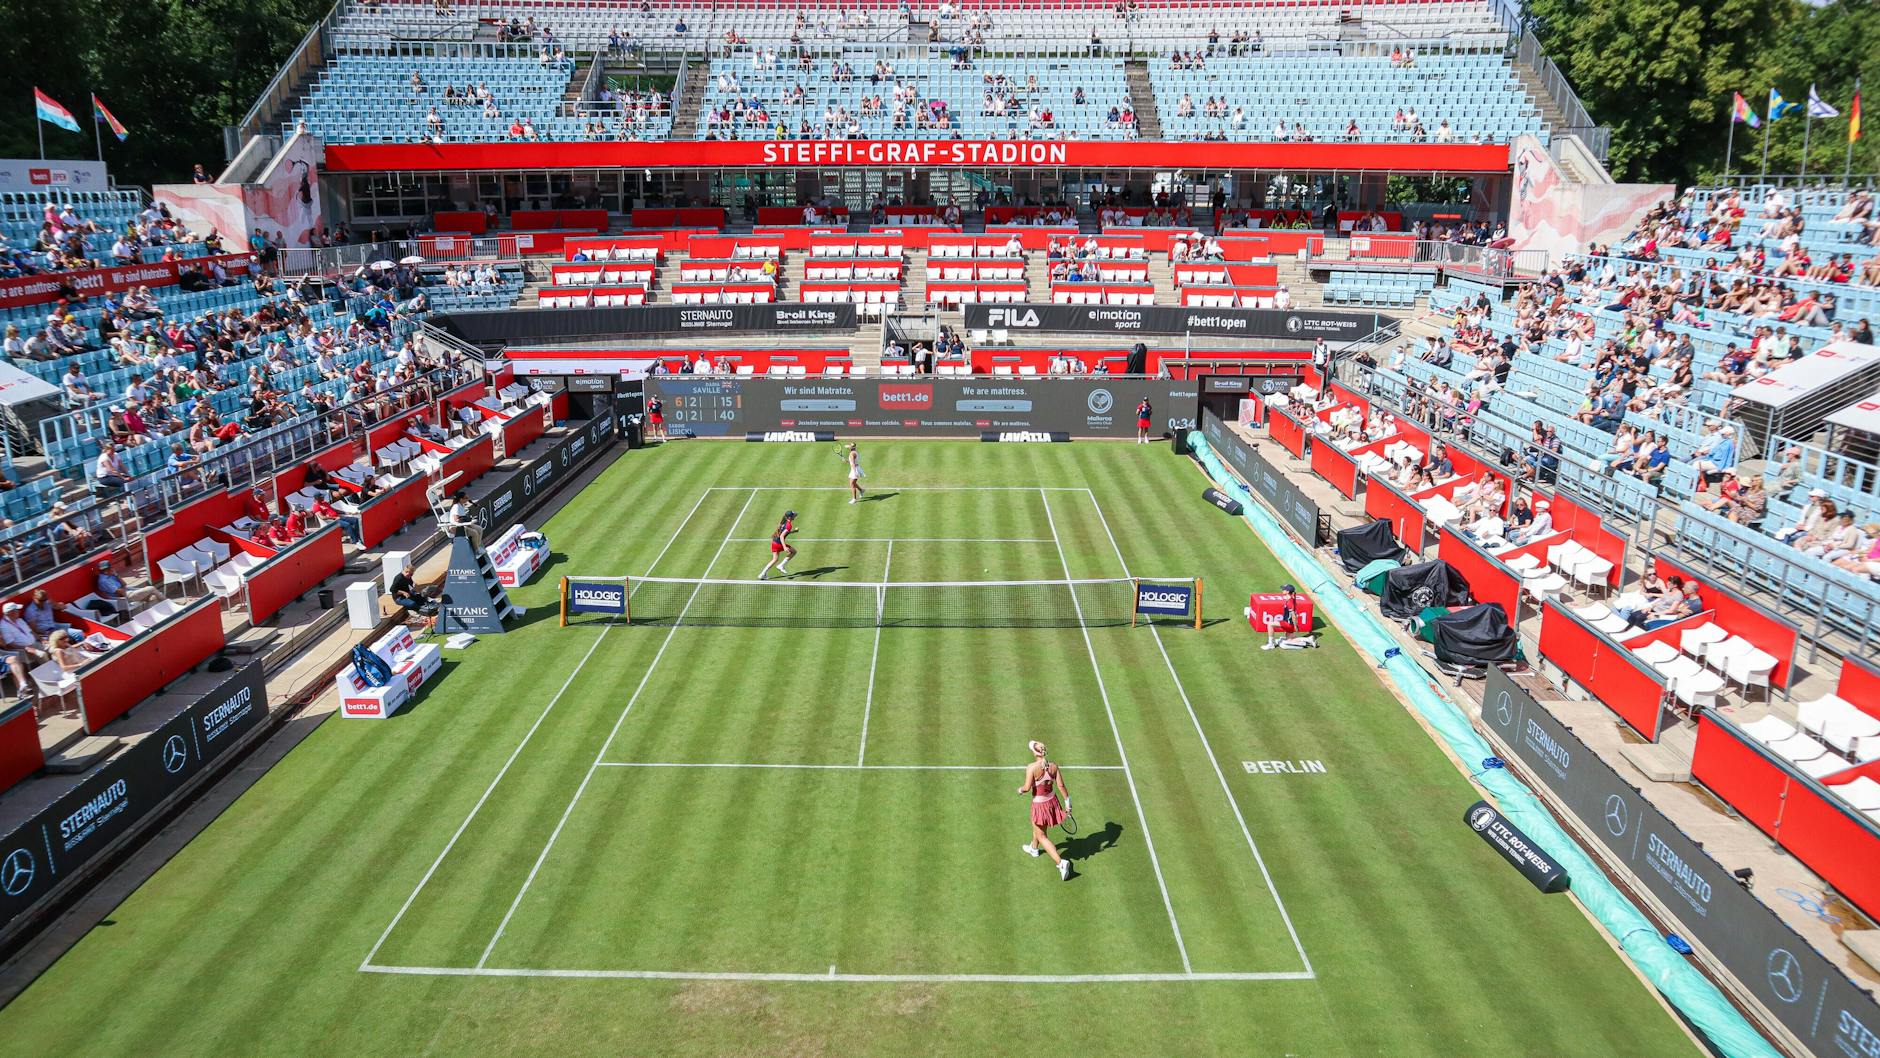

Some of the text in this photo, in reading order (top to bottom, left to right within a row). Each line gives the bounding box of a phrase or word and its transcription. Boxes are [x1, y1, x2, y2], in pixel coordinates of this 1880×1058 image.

[763, 143, 1067, 163] STEFFI-GRAF-STADION
[112, 271, 125, 284] Wir
[8, 286, 24, 297] are
[680, 309, 733, 321] STERNAUTO
[776, 310, 805, 320] Broil
[988, 308, 1040, 327] FILA
[1114, 321, 1141, 330] sports
[1187, 315, 1247, 331] #bett1open
[1304, 319, 1320, 327] LTTC
[1320, 320, 1358, 328] ROT-WEISS
[783, 386, 854, 396] Wir sind Matratze.
[882, 392, 929, 402] bett1.de
[962, 386, 1028, 396] We are mattress.
[675, 396, 733, 407] 6 2 15
[675, 410, 735, 421] 0 2 40
[763, 430, 816, 442] LAVAZZA
[999, 430, 1052, 442] LAVAZZA
[574, 589, 621, 601] HOLOGIC
[1139, 591, 1188, 603] HOLOGIC
[446, 607, 489, 616] TITANIC
[1262, 611, 1307, 625] be1
[203, 686, 251, 731] STERNAUTO
[346, 703, 379, 711] bett1.de
[1526, 718, 1570, 769] STERNAUTO
[1241, 759, 1328, 774] BERLIN
[60, 778, 127, 839] STERNAUTO
[1491, 821, 1552, 874] LTTC ROT-WEISS
[1648, 832, 1712, 903] STERNAUTO
